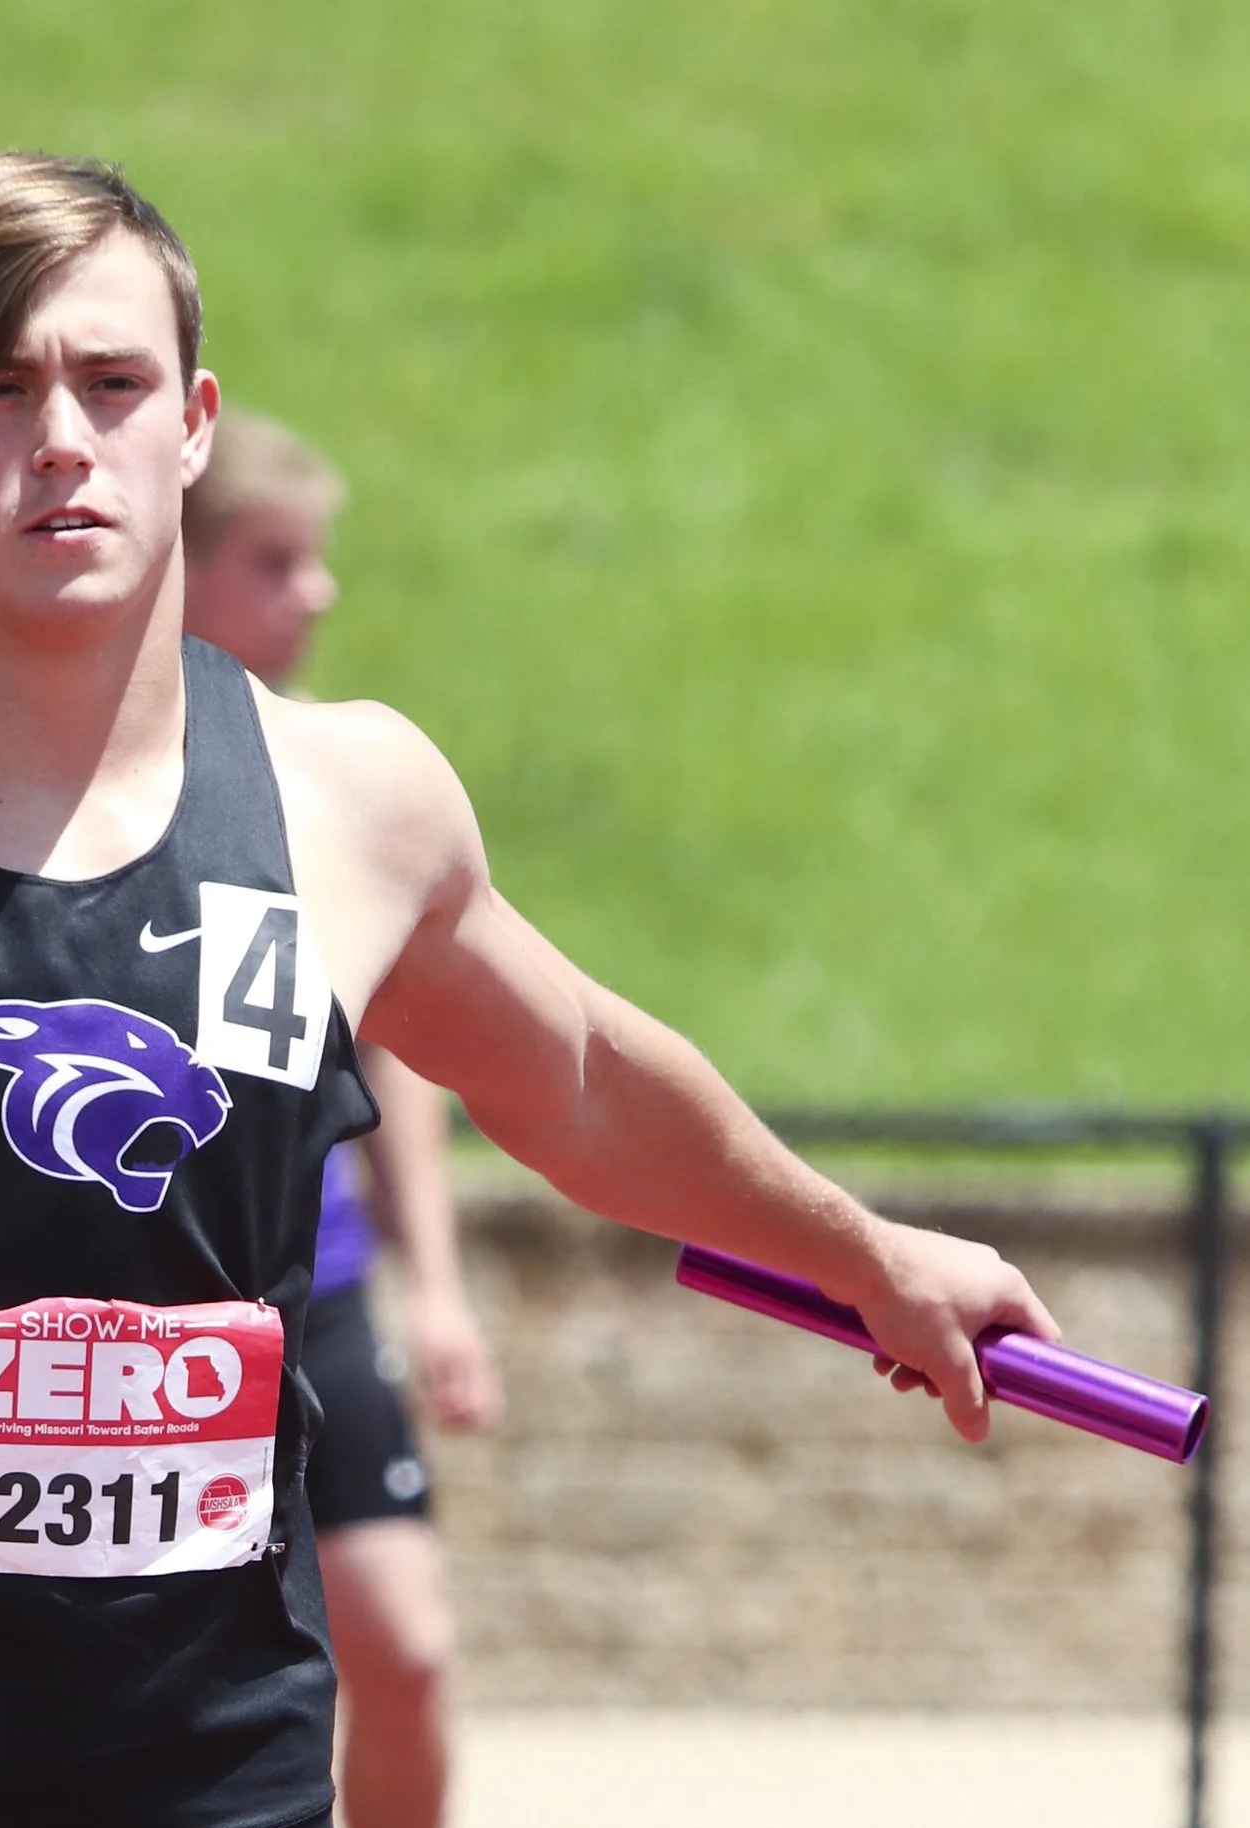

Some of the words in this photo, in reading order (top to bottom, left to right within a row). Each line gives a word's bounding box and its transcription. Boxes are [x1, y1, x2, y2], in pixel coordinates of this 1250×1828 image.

[222, 906, 308, 1072] 4
[20, 1311, 181, 1340] SHOW-ME
[34, 1423, 84, 1436] Missouri
[87, 1424, 131, 1436] Toward
[133, 1423, 164, 1436] Safer
[167, 1421, 200, 1434] Roads
[205, 1497, 240, 1511] MSHSAA
